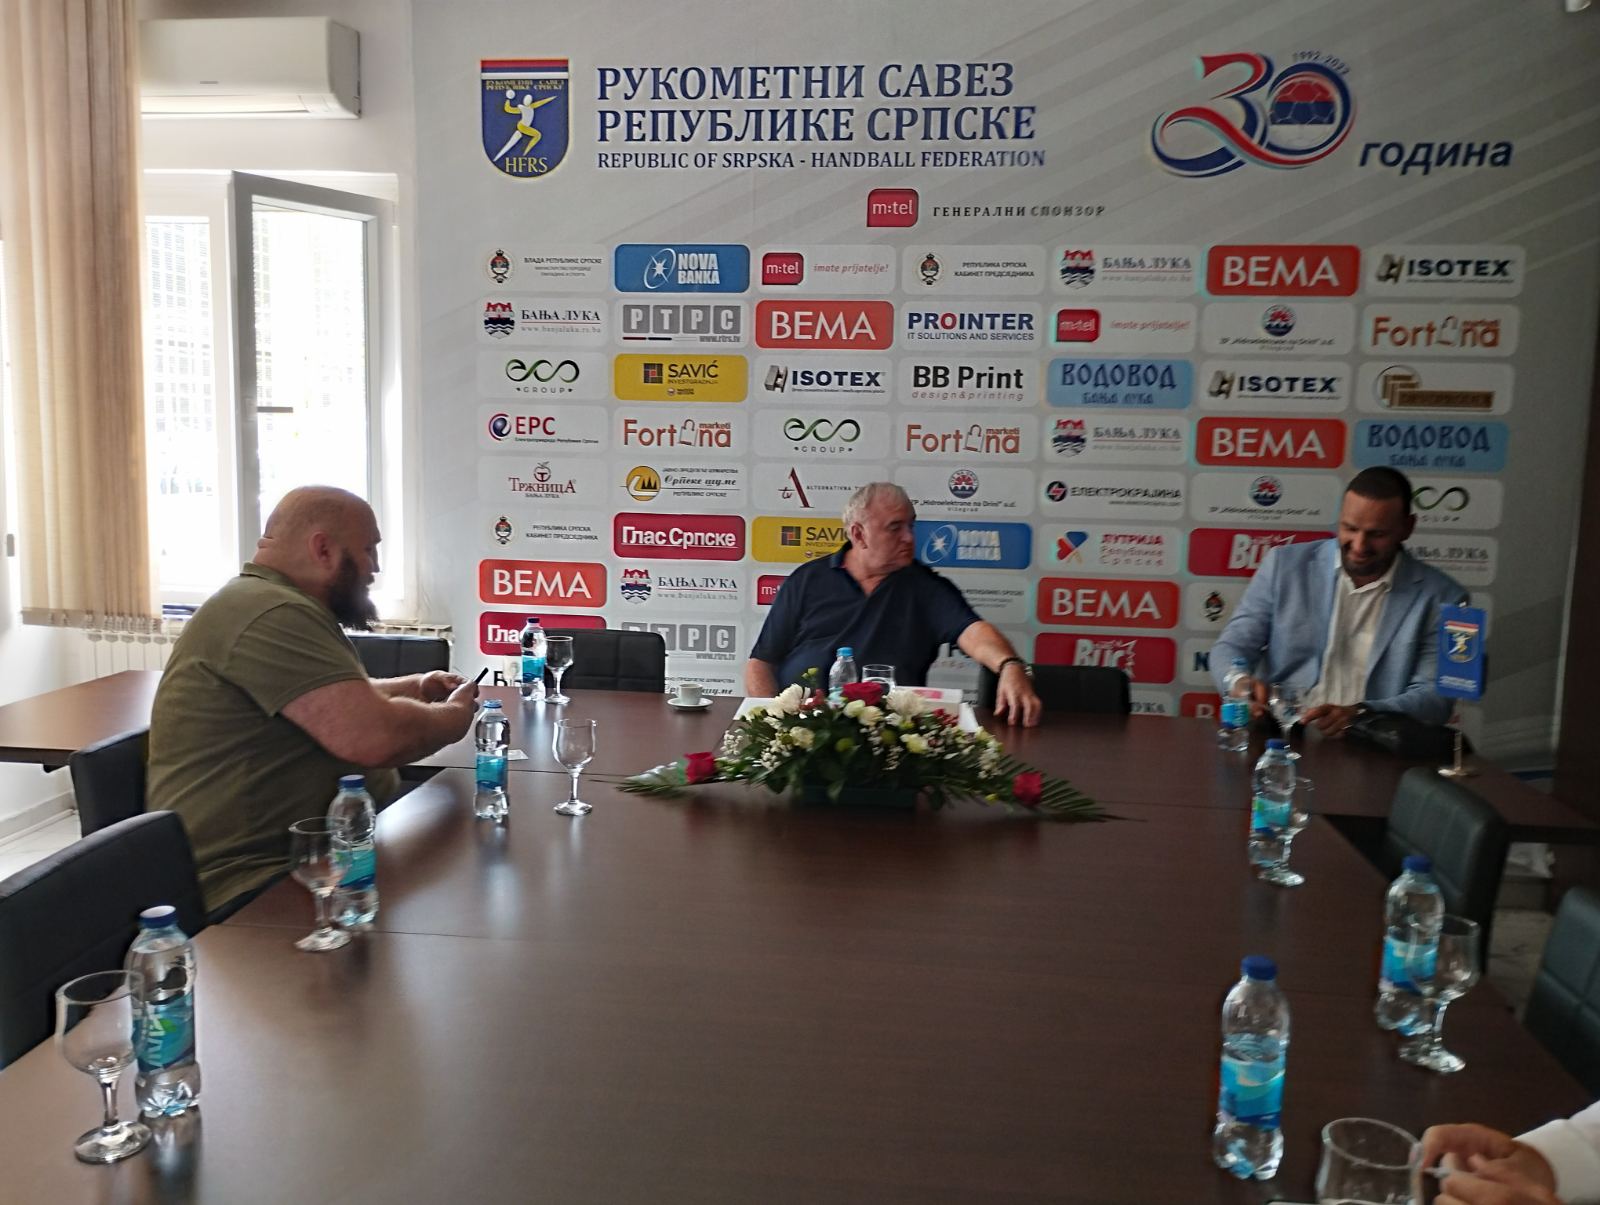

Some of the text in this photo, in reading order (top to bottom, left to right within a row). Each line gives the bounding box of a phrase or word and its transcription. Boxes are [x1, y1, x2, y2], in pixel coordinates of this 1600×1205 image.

[597, 62, 1014, 101] РУКОМЕТНИ САВЕЗ
[597, 106, 1037, 142] РЕПУБЛИКЕ СРПСКЕ
[505, 156, 548, 173] HFRS
[598, 152, 689, 168] REPUBLIC
[694, 152, 718, 168] OF
[722, 152, 795, 168] SRPSKA
[811, 151, 916, 168] HANDBALL
[921, 150, 1046, 167] FEDERATION
[1359, 141, 1514, 176] година
[872, 199, 913, 215] m:tel
[933, 205, 1106, 217] ГЕНЕРАЛНИ СПОНЗОР
[678, 253, 719, 270] NOVA
[766, 261, 800, 274] m:tel
[814, 264, 840, 273] imate
[1407, 259, 1511, 277] ISOTEX
[678, 270, 720, 285] BANKA
[1222, 256, 1340, 287] BEMA
[521, 310, 601, 321] БАЊА ЛУКА
[908, 312, 1034, 330] PROINTER
[771, 311, 877, 340] BEMA
[990, 333, 1034, 341] SERVICES
[668, 360, 719, 378] SAVIĆ
[913, 365, 1024, 389] BB Print
[1061, 363, 1177, 389] ВОДОВОД
[792, 370, 881, 387] ISOTEX
[1239, 376, 1338, 393] ISOTEX
[911, 390, 1024, 401] design&printing
[1211, 428, 1326, 459] BEMA
[1368, 424, 1490, 452] ВОДОВОД
[622, 526, 736, 549] Глас Српске
[493, 569, 592, 598] BEMA
[658, 577, 738, 589] БАЊА ЛУКА
[1052, 588, 1162, 620] BEMA
[487, 624, 521, 642] Гла
